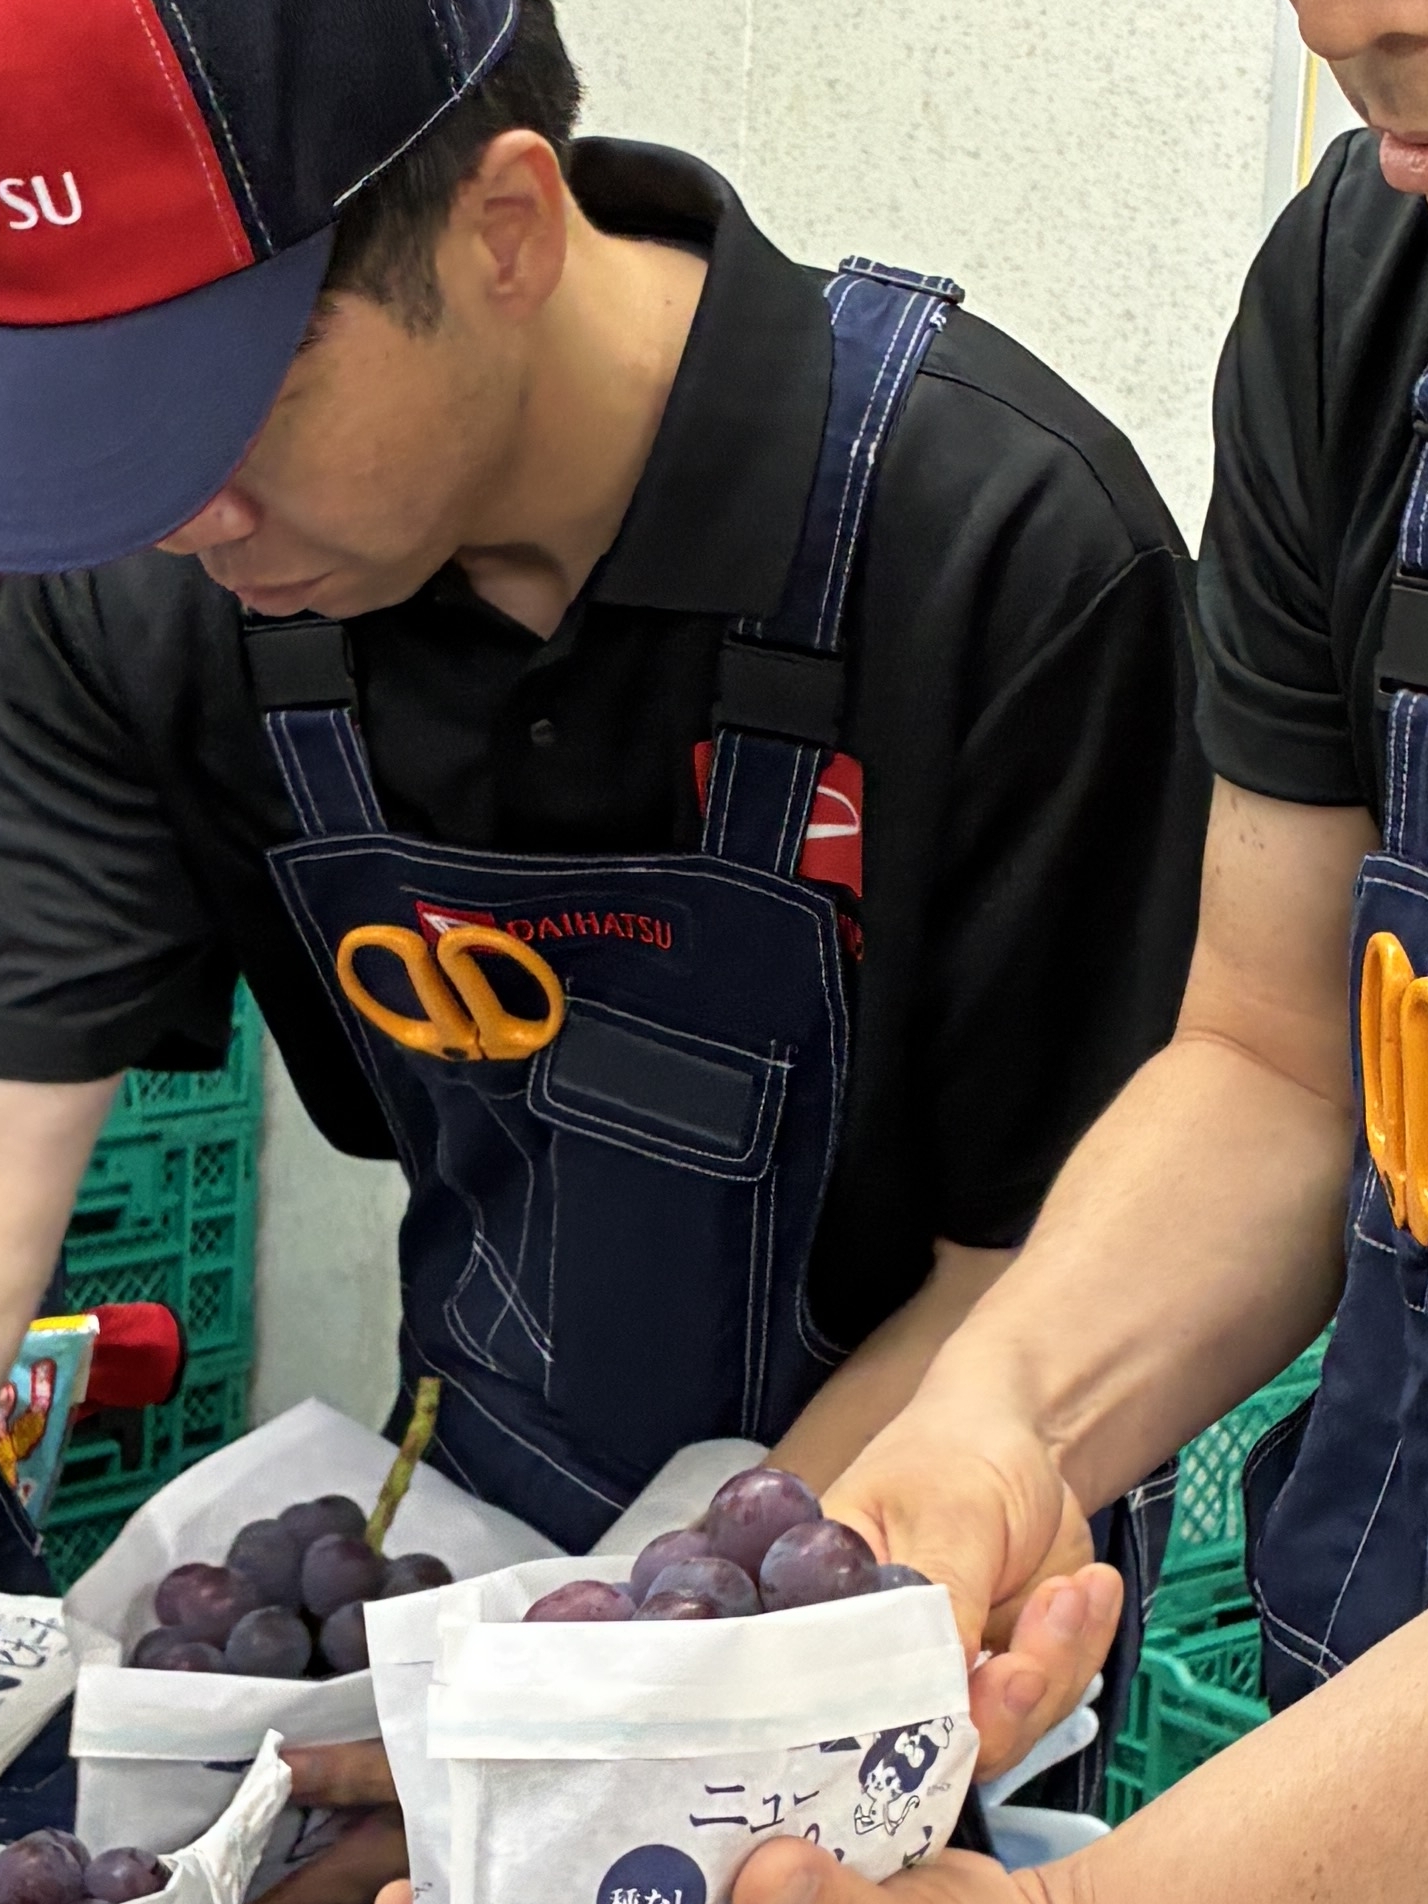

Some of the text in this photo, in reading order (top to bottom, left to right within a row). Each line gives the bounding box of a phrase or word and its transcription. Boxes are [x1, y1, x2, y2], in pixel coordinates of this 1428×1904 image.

[505, 910, 673, 951] DAIHATSU
[688, 1782, 821, 1834] ニュー
